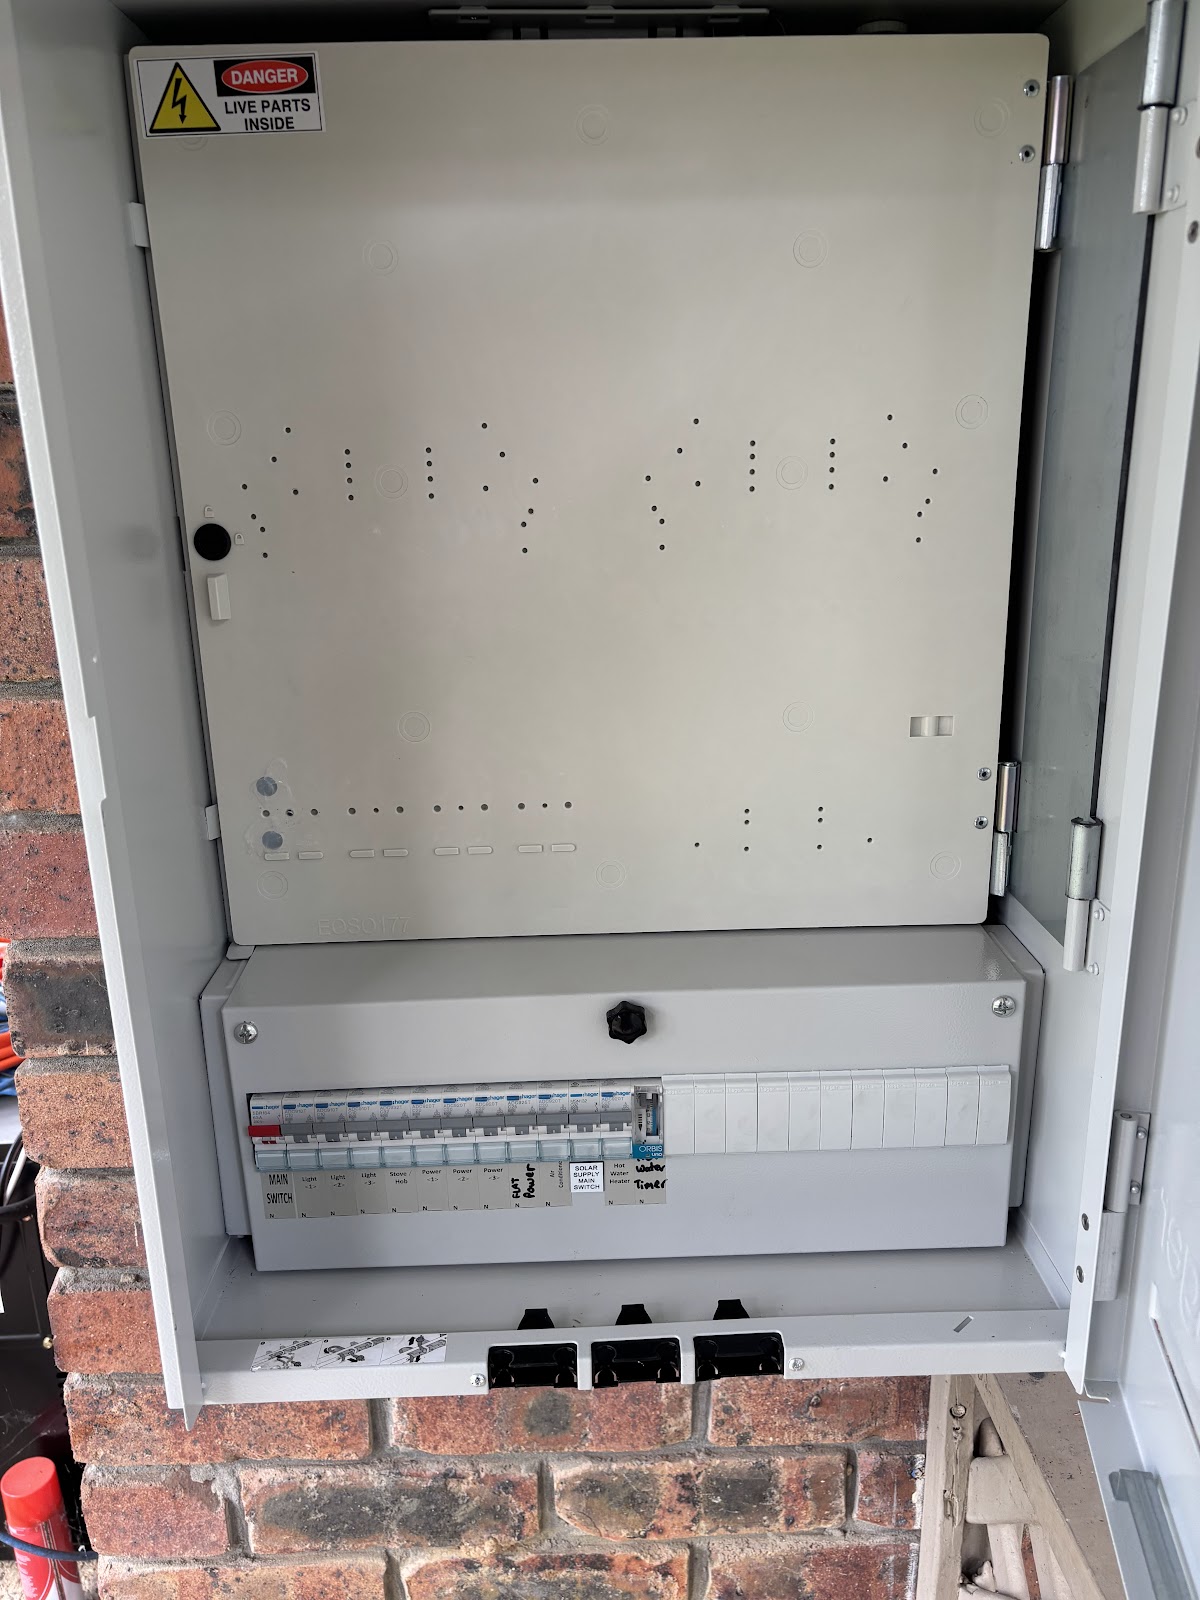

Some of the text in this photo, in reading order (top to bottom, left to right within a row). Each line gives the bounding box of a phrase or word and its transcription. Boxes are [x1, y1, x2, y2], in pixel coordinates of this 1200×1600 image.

[231, 68, 299, 85] DANGER
[225, 98, 311, 114] LIVE PARTS
[244, 117, 295, 131] INSIDE
[268, 1173, 288, 1185] MAIN
[523, 1163, 535, 1198] Power
[634, 1179, 668, 1190] Timer
[511, 1177, 521, 1198] FLAT
[266, 1192, 293, 1204] SWITCH
